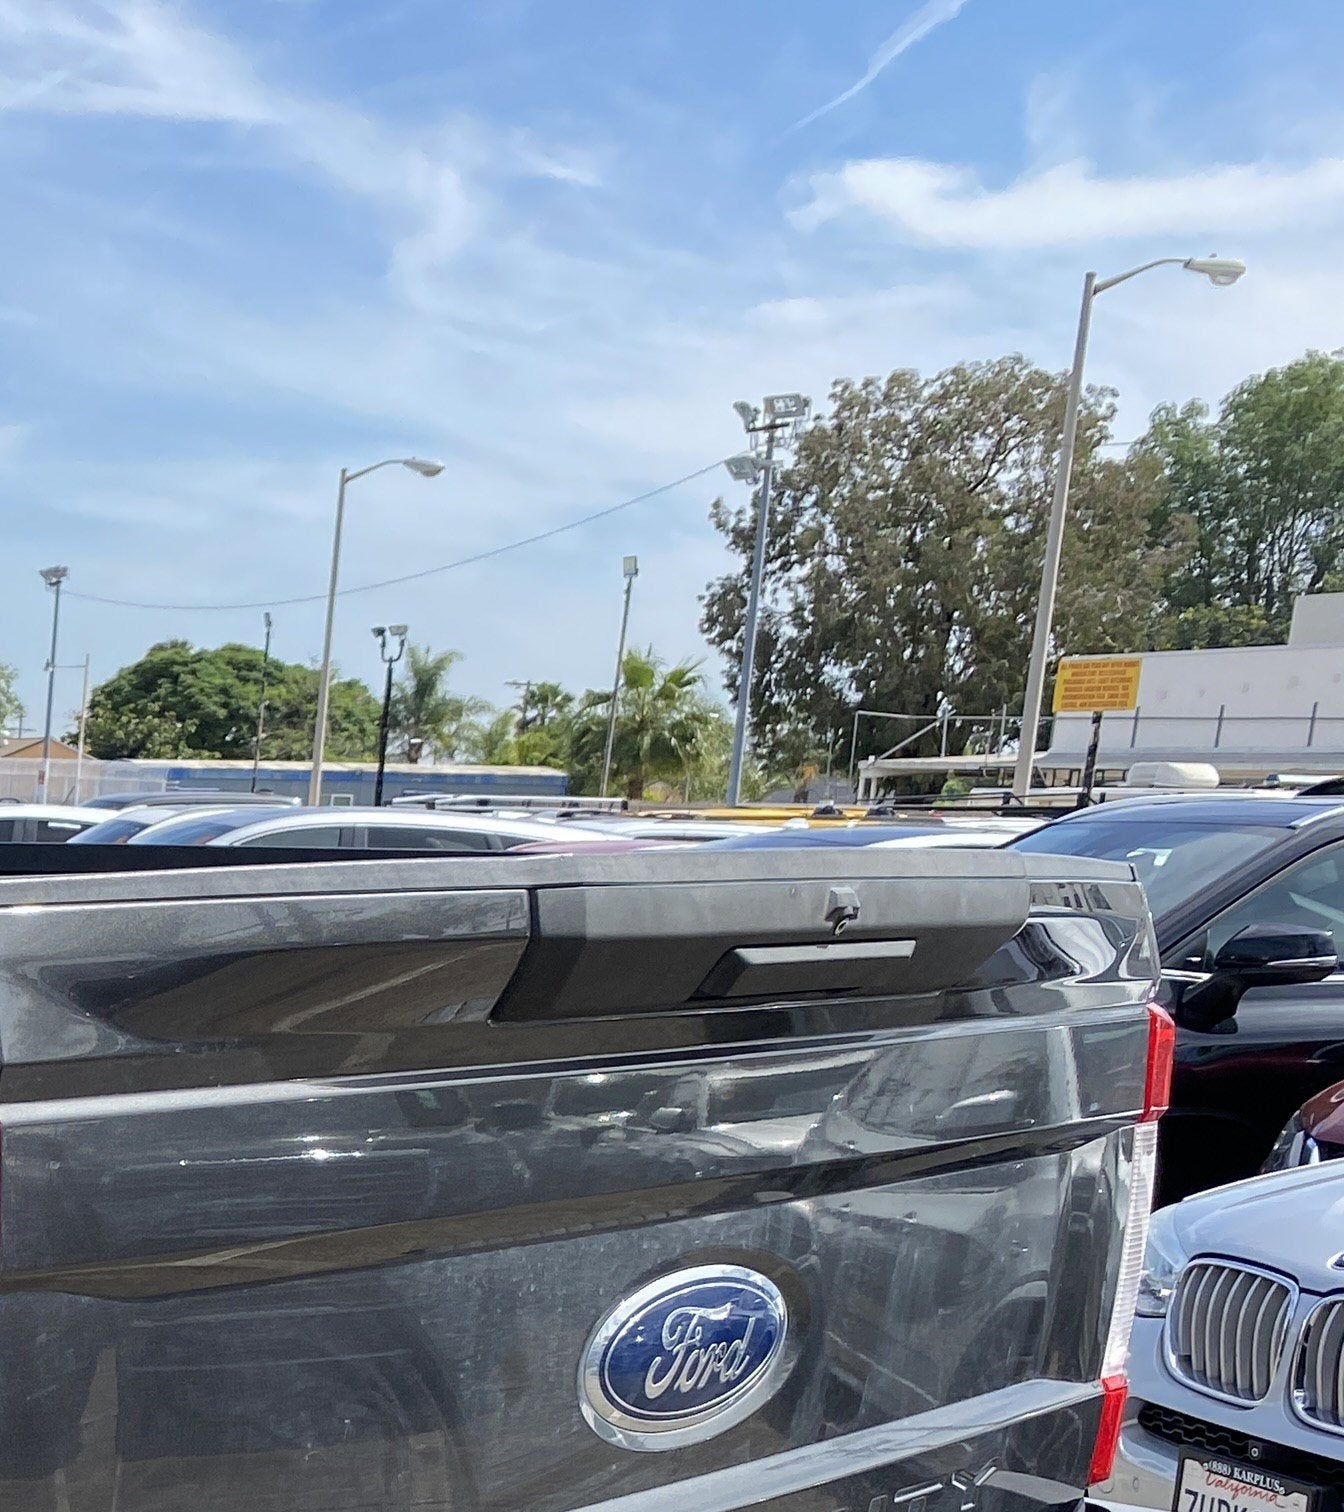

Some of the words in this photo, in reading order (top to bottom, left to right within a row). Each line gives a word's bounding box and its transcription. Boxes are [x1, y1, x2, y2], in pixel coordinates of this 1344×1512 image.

[645, 1302, 756, 1399] Ford
[1208, 1460, 1231, 1475] (888)
[1233, 1467, 1281, 1491] KARPLUS
